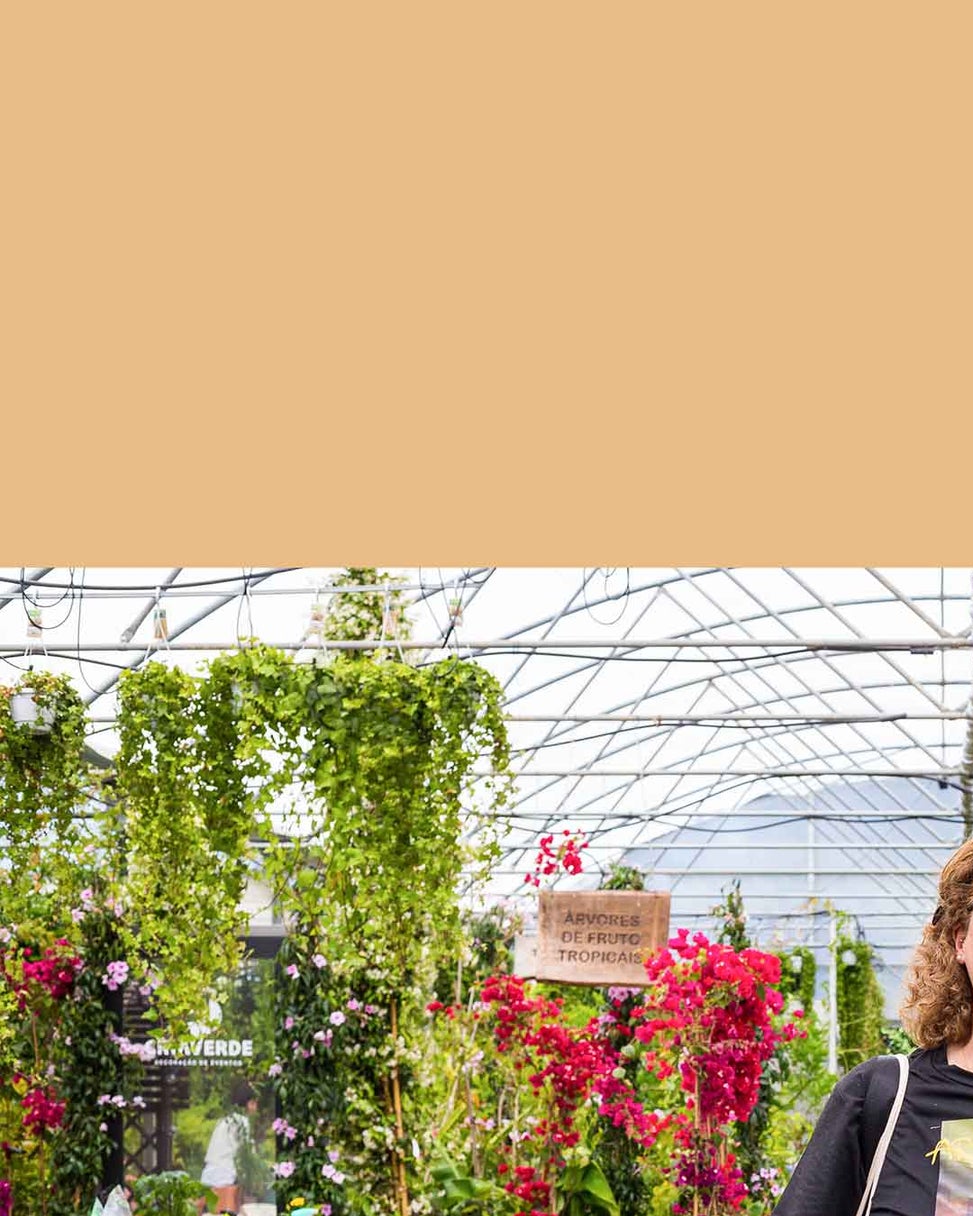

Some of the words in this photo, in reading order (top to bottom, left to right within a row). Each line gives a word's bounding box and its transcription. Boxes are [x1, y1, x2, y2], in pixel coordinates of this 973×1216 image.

[565, 910, 641, 927] ÁRVORES
[561, 931, 583, 943] DE
[587, 932, 641, 945] FRUTO
[558, 949, 643, 964] TROPICAIS
